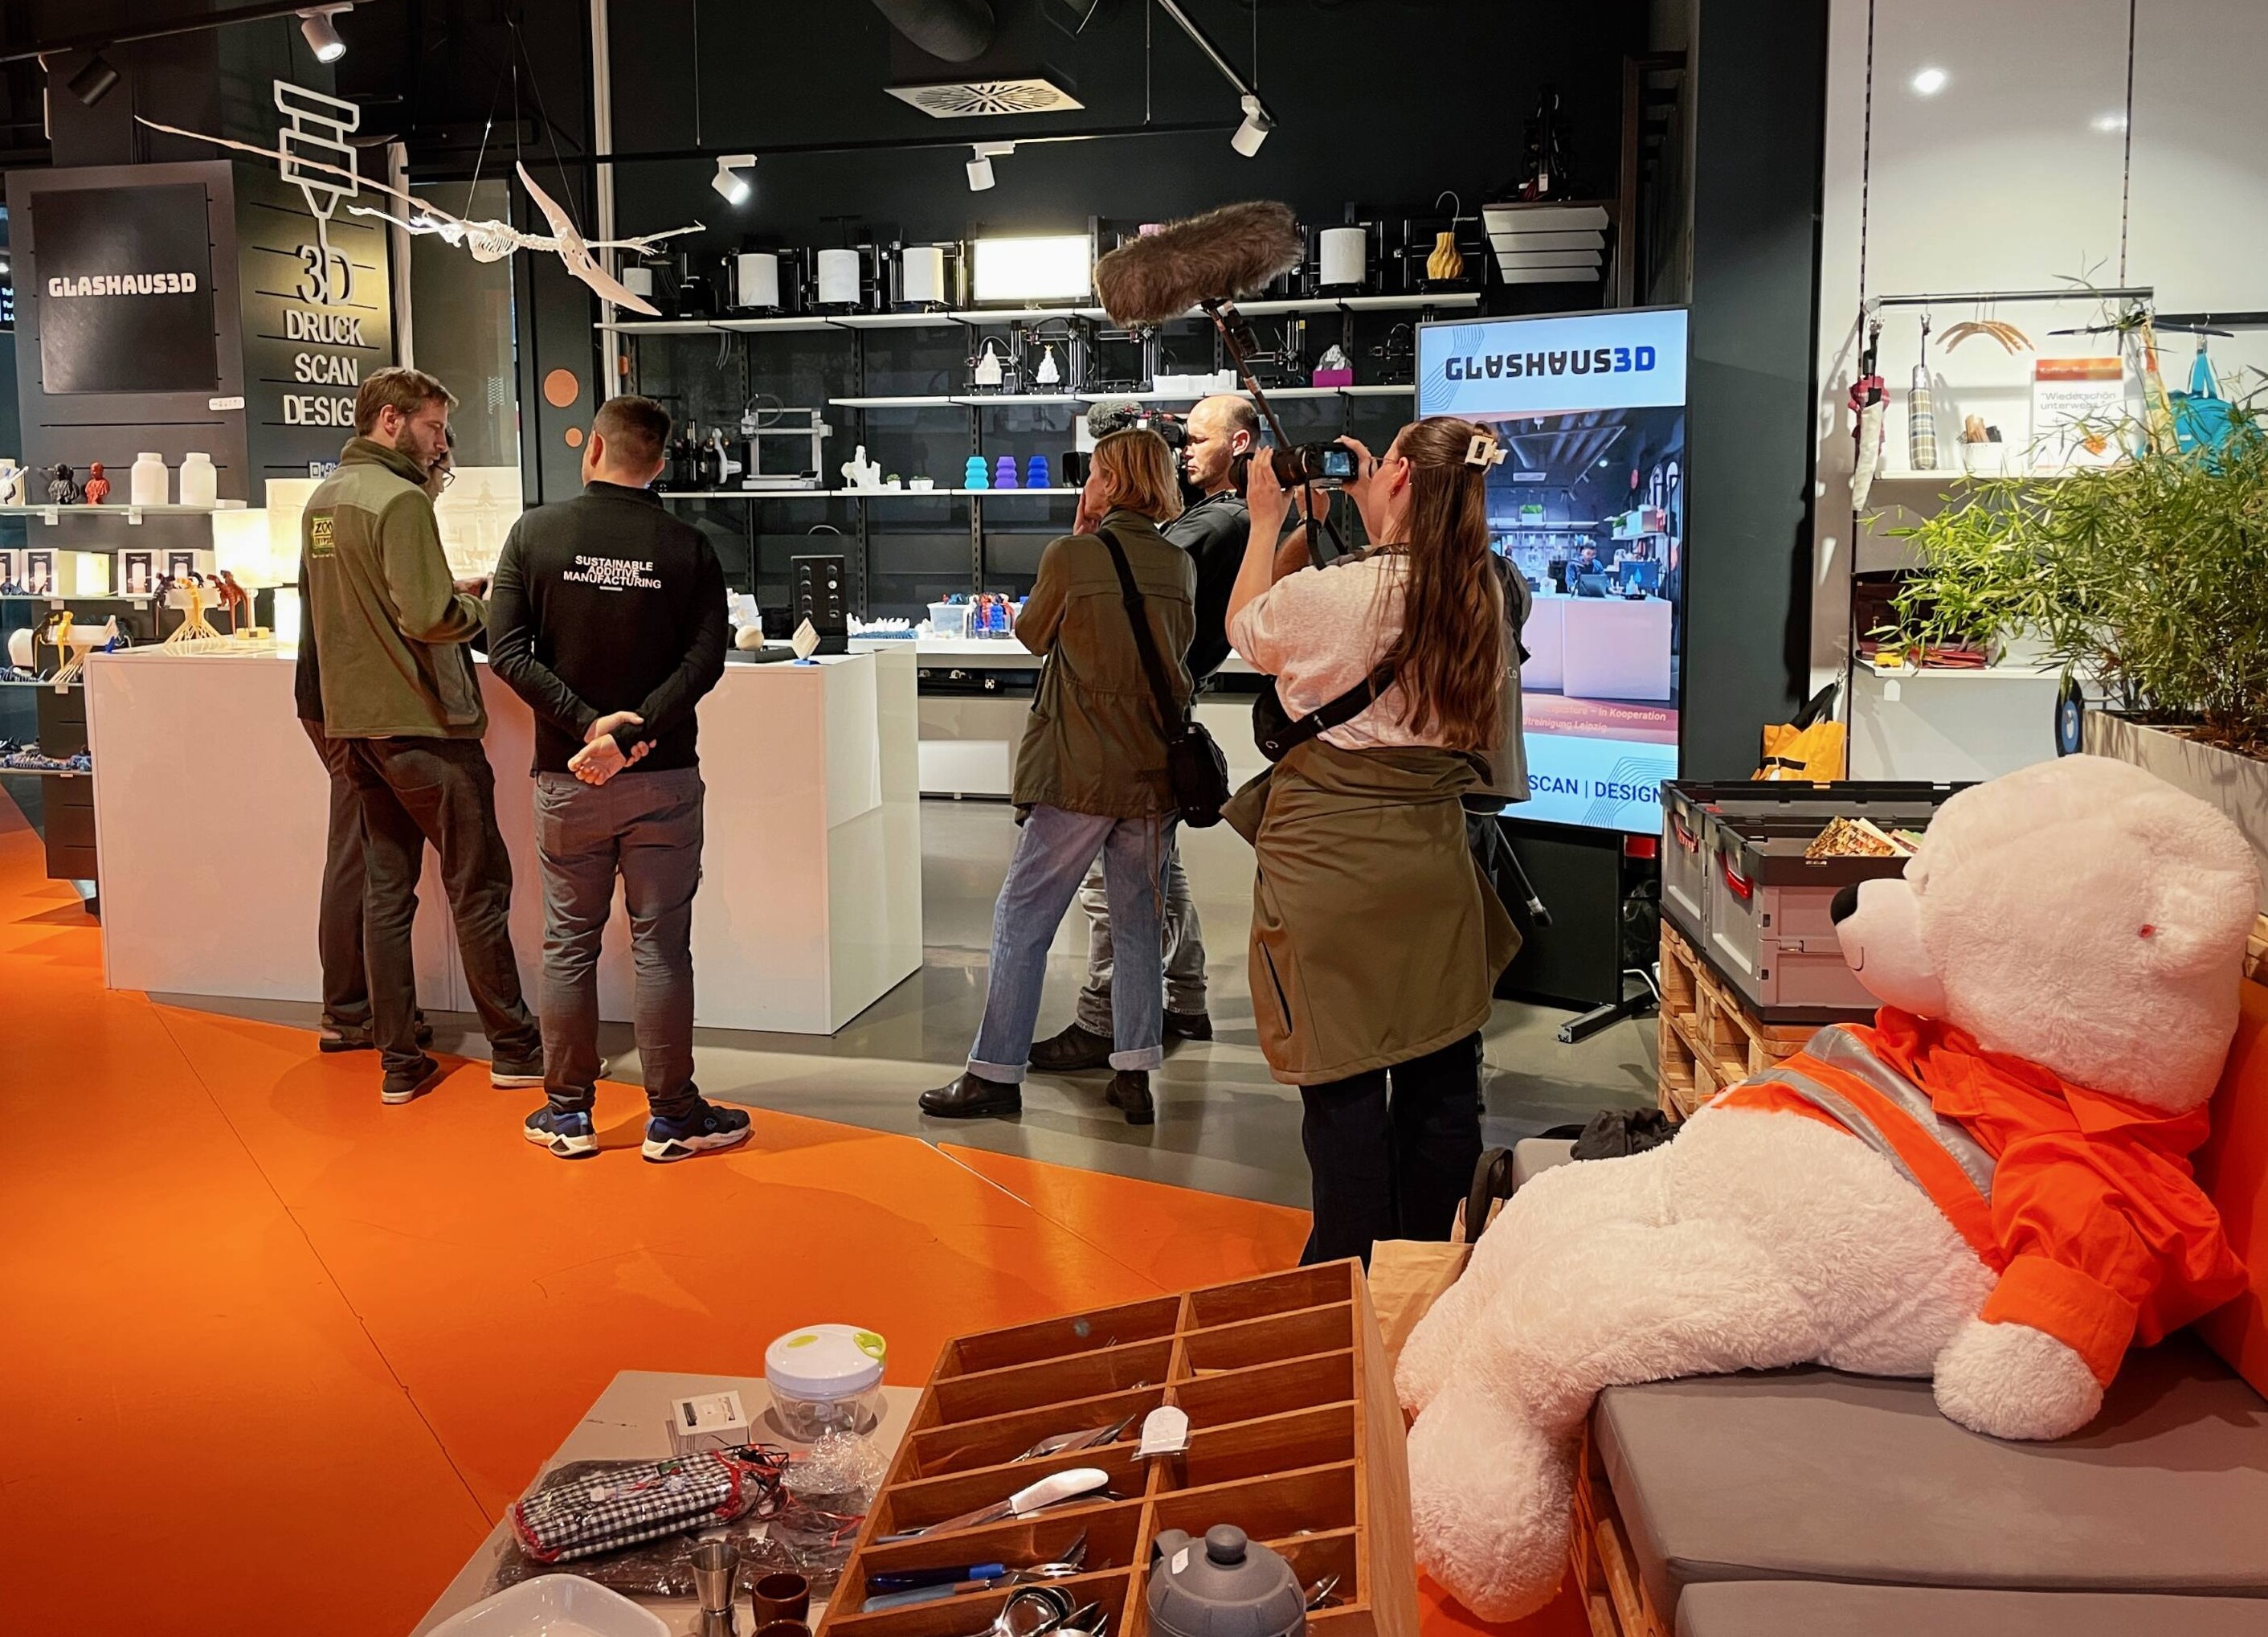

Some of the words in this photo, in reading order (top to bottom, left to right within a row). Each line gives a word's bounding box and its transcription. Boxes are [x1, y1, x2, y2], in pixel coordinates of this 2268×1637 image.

[48, 272, 197, 297] GLASHAUS3D
[298, 244, 354, 306] 3D
[285, 309, 366, 346] DRUCK
[294, 352, 358, 387] SCAN
[1445, 346, 1656, 381] GLASHAUS3D
[283, 394, 356, 427] DESIG
[575, 555, 654, 571] SUSTAINABLE
[587, 565, 640, 579] ADDITIVE
[563, 570, 662, 589] MANUFACTURING
[1609, 707, 1666, 722] Kooperation
[1529, 775, 1578, 794] SCAN
